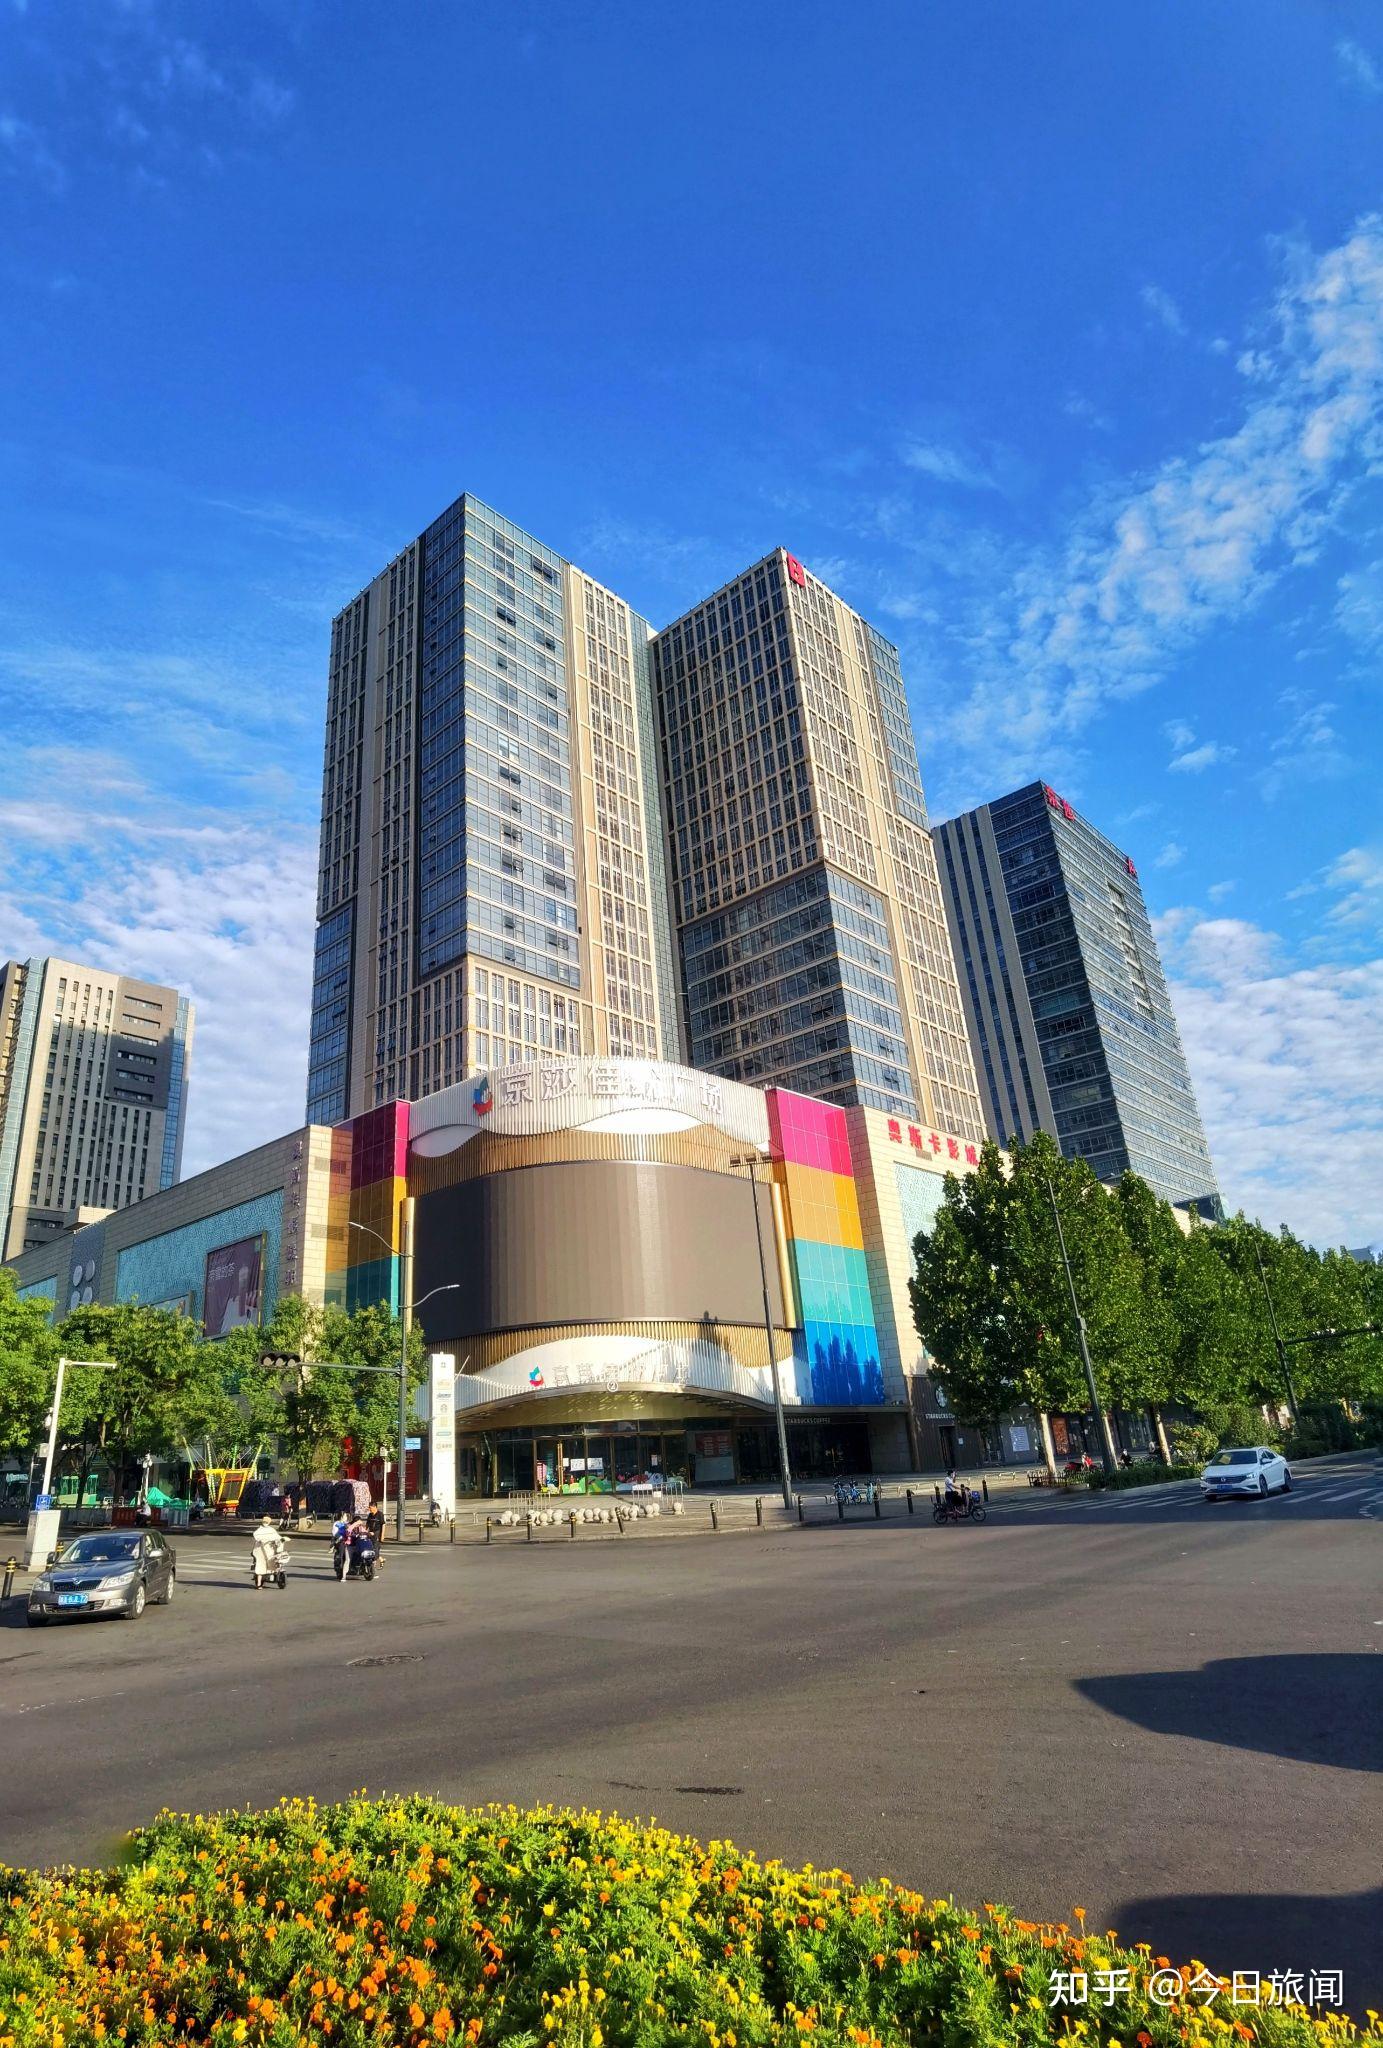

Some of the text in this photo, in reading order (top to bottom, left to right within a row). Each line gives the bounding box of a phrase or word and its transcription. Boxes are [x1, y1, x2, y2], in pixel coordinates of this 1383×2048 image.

[887, 1118, 980, 1167] 奥斯卡影城
